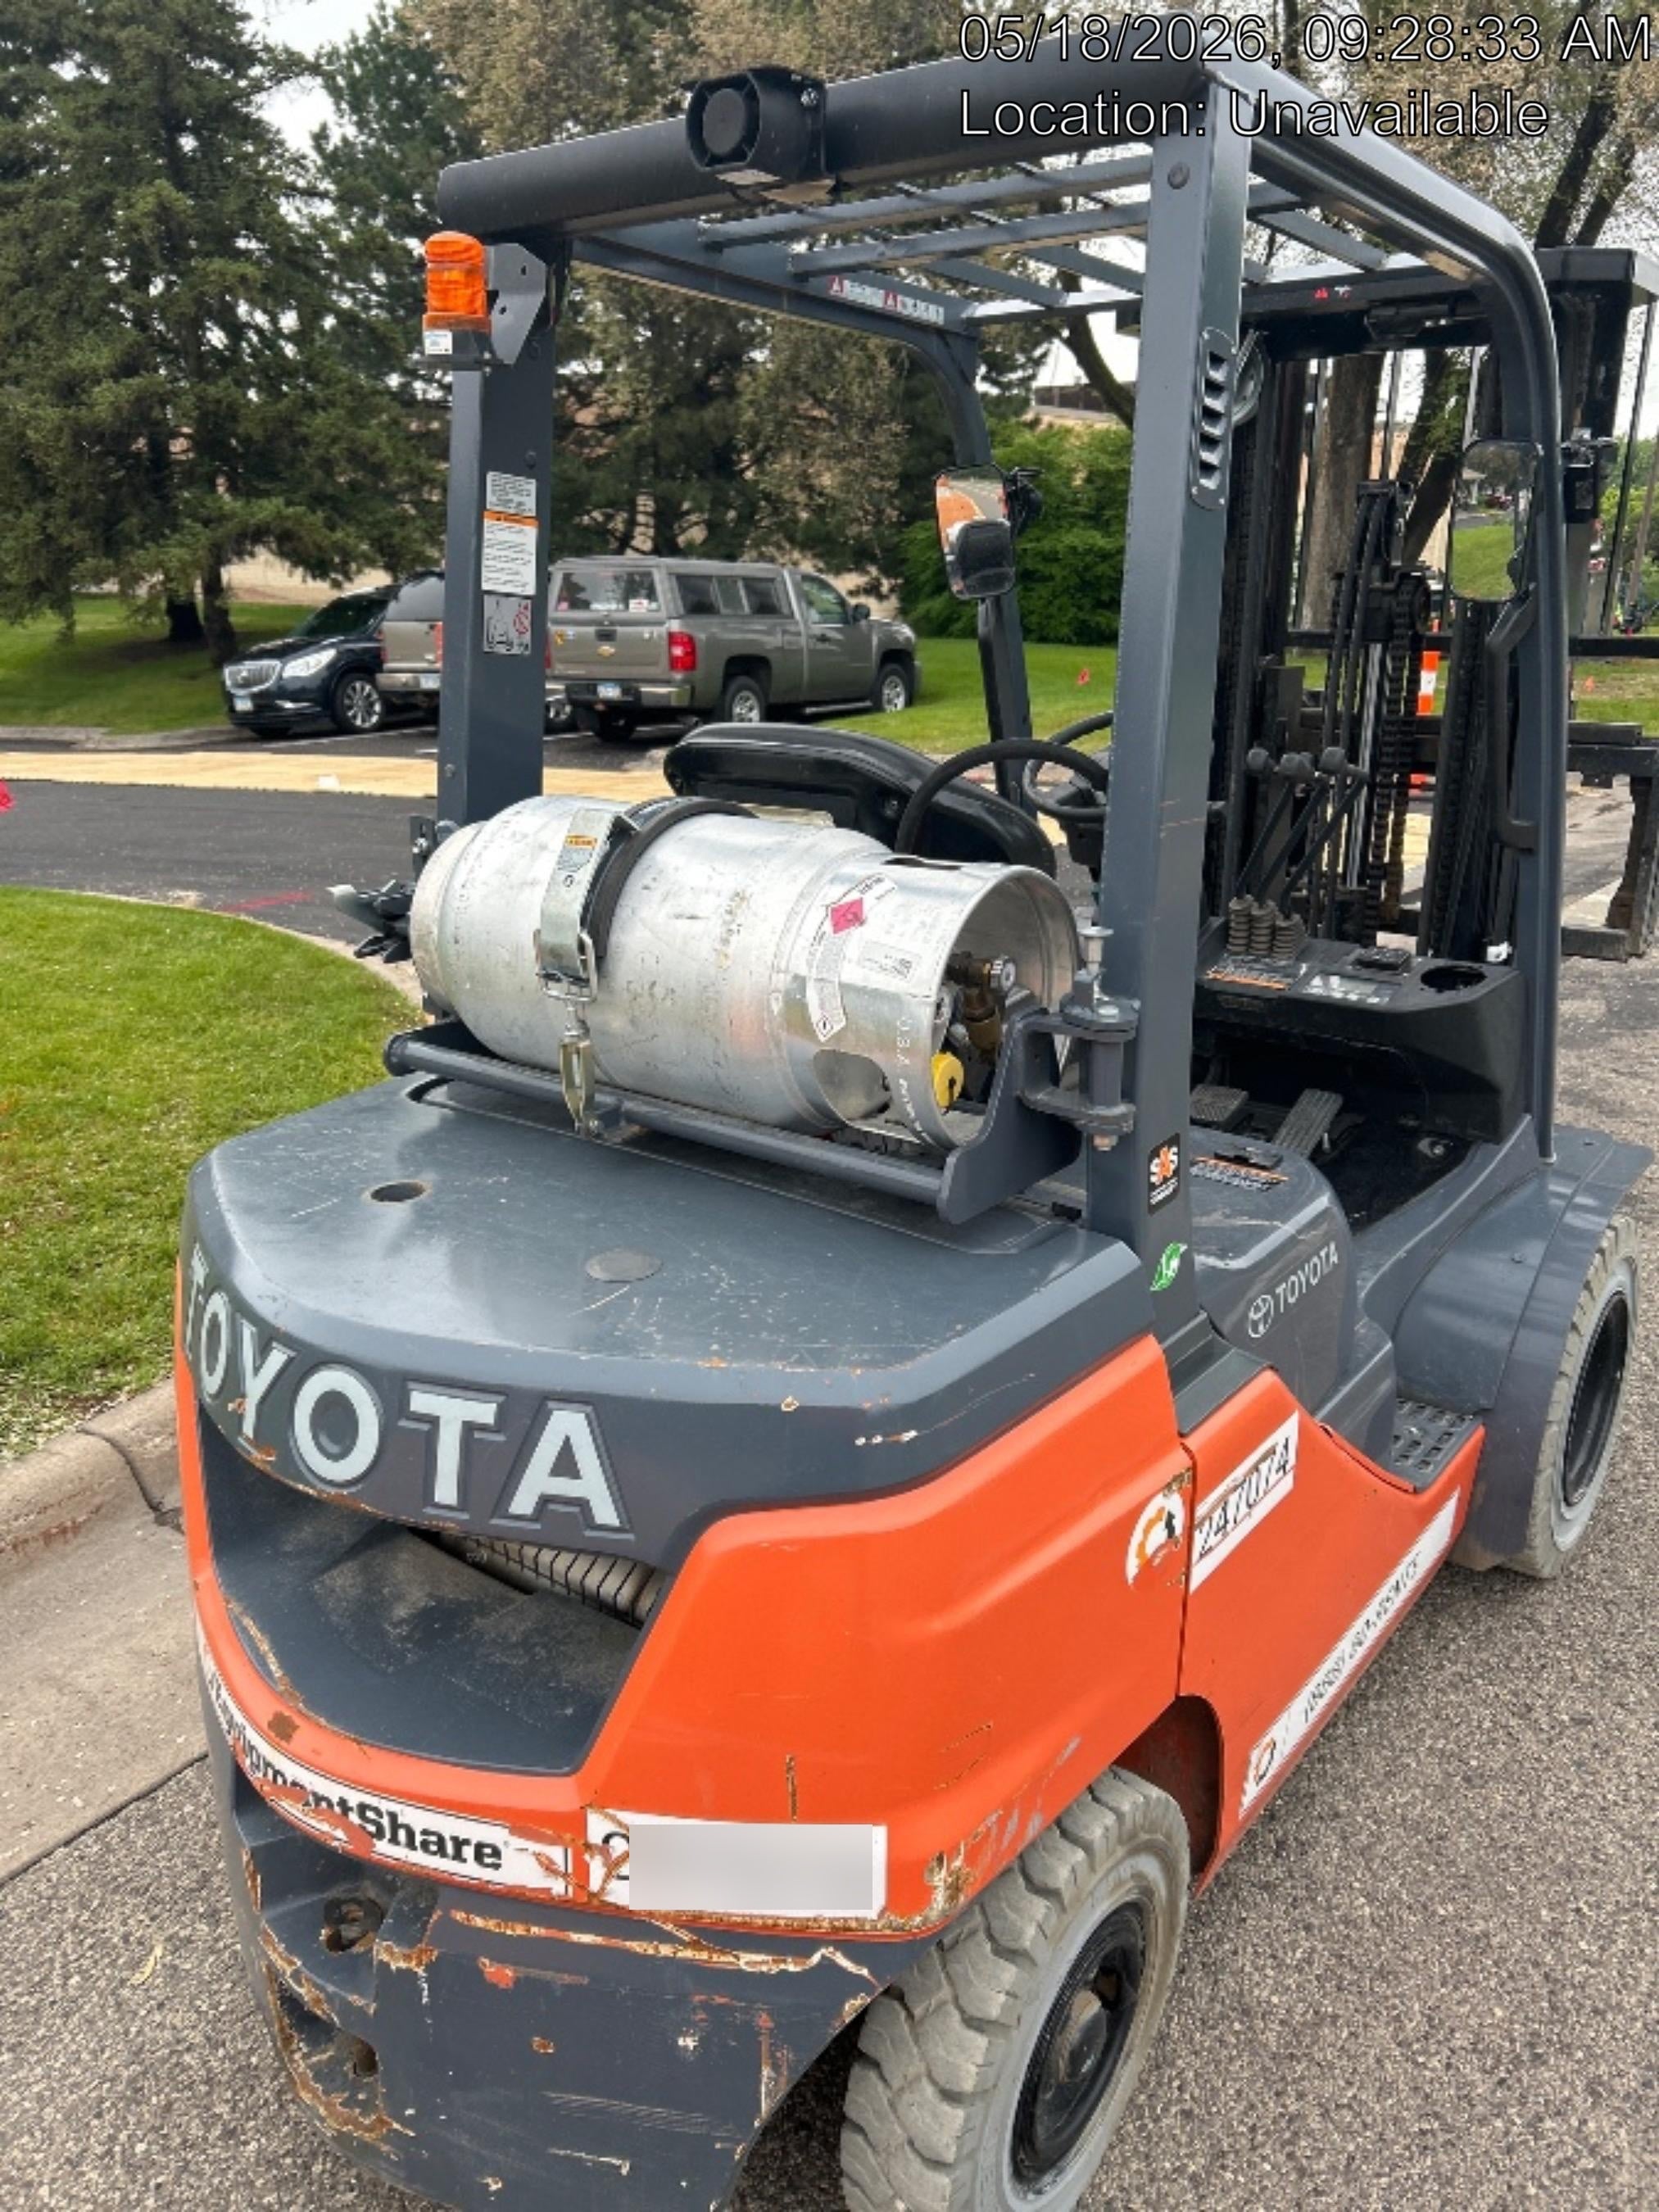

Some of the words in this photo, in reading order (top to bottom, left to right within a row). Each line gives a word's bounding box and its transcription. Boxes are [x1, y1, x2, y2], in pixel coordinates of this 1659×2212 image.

[1275, 1240, 1339, 1314] TOYOTA
[185, 1241, 621, 1527] TOYOTA
[1197, 1436, 1290, 1561] 247074
